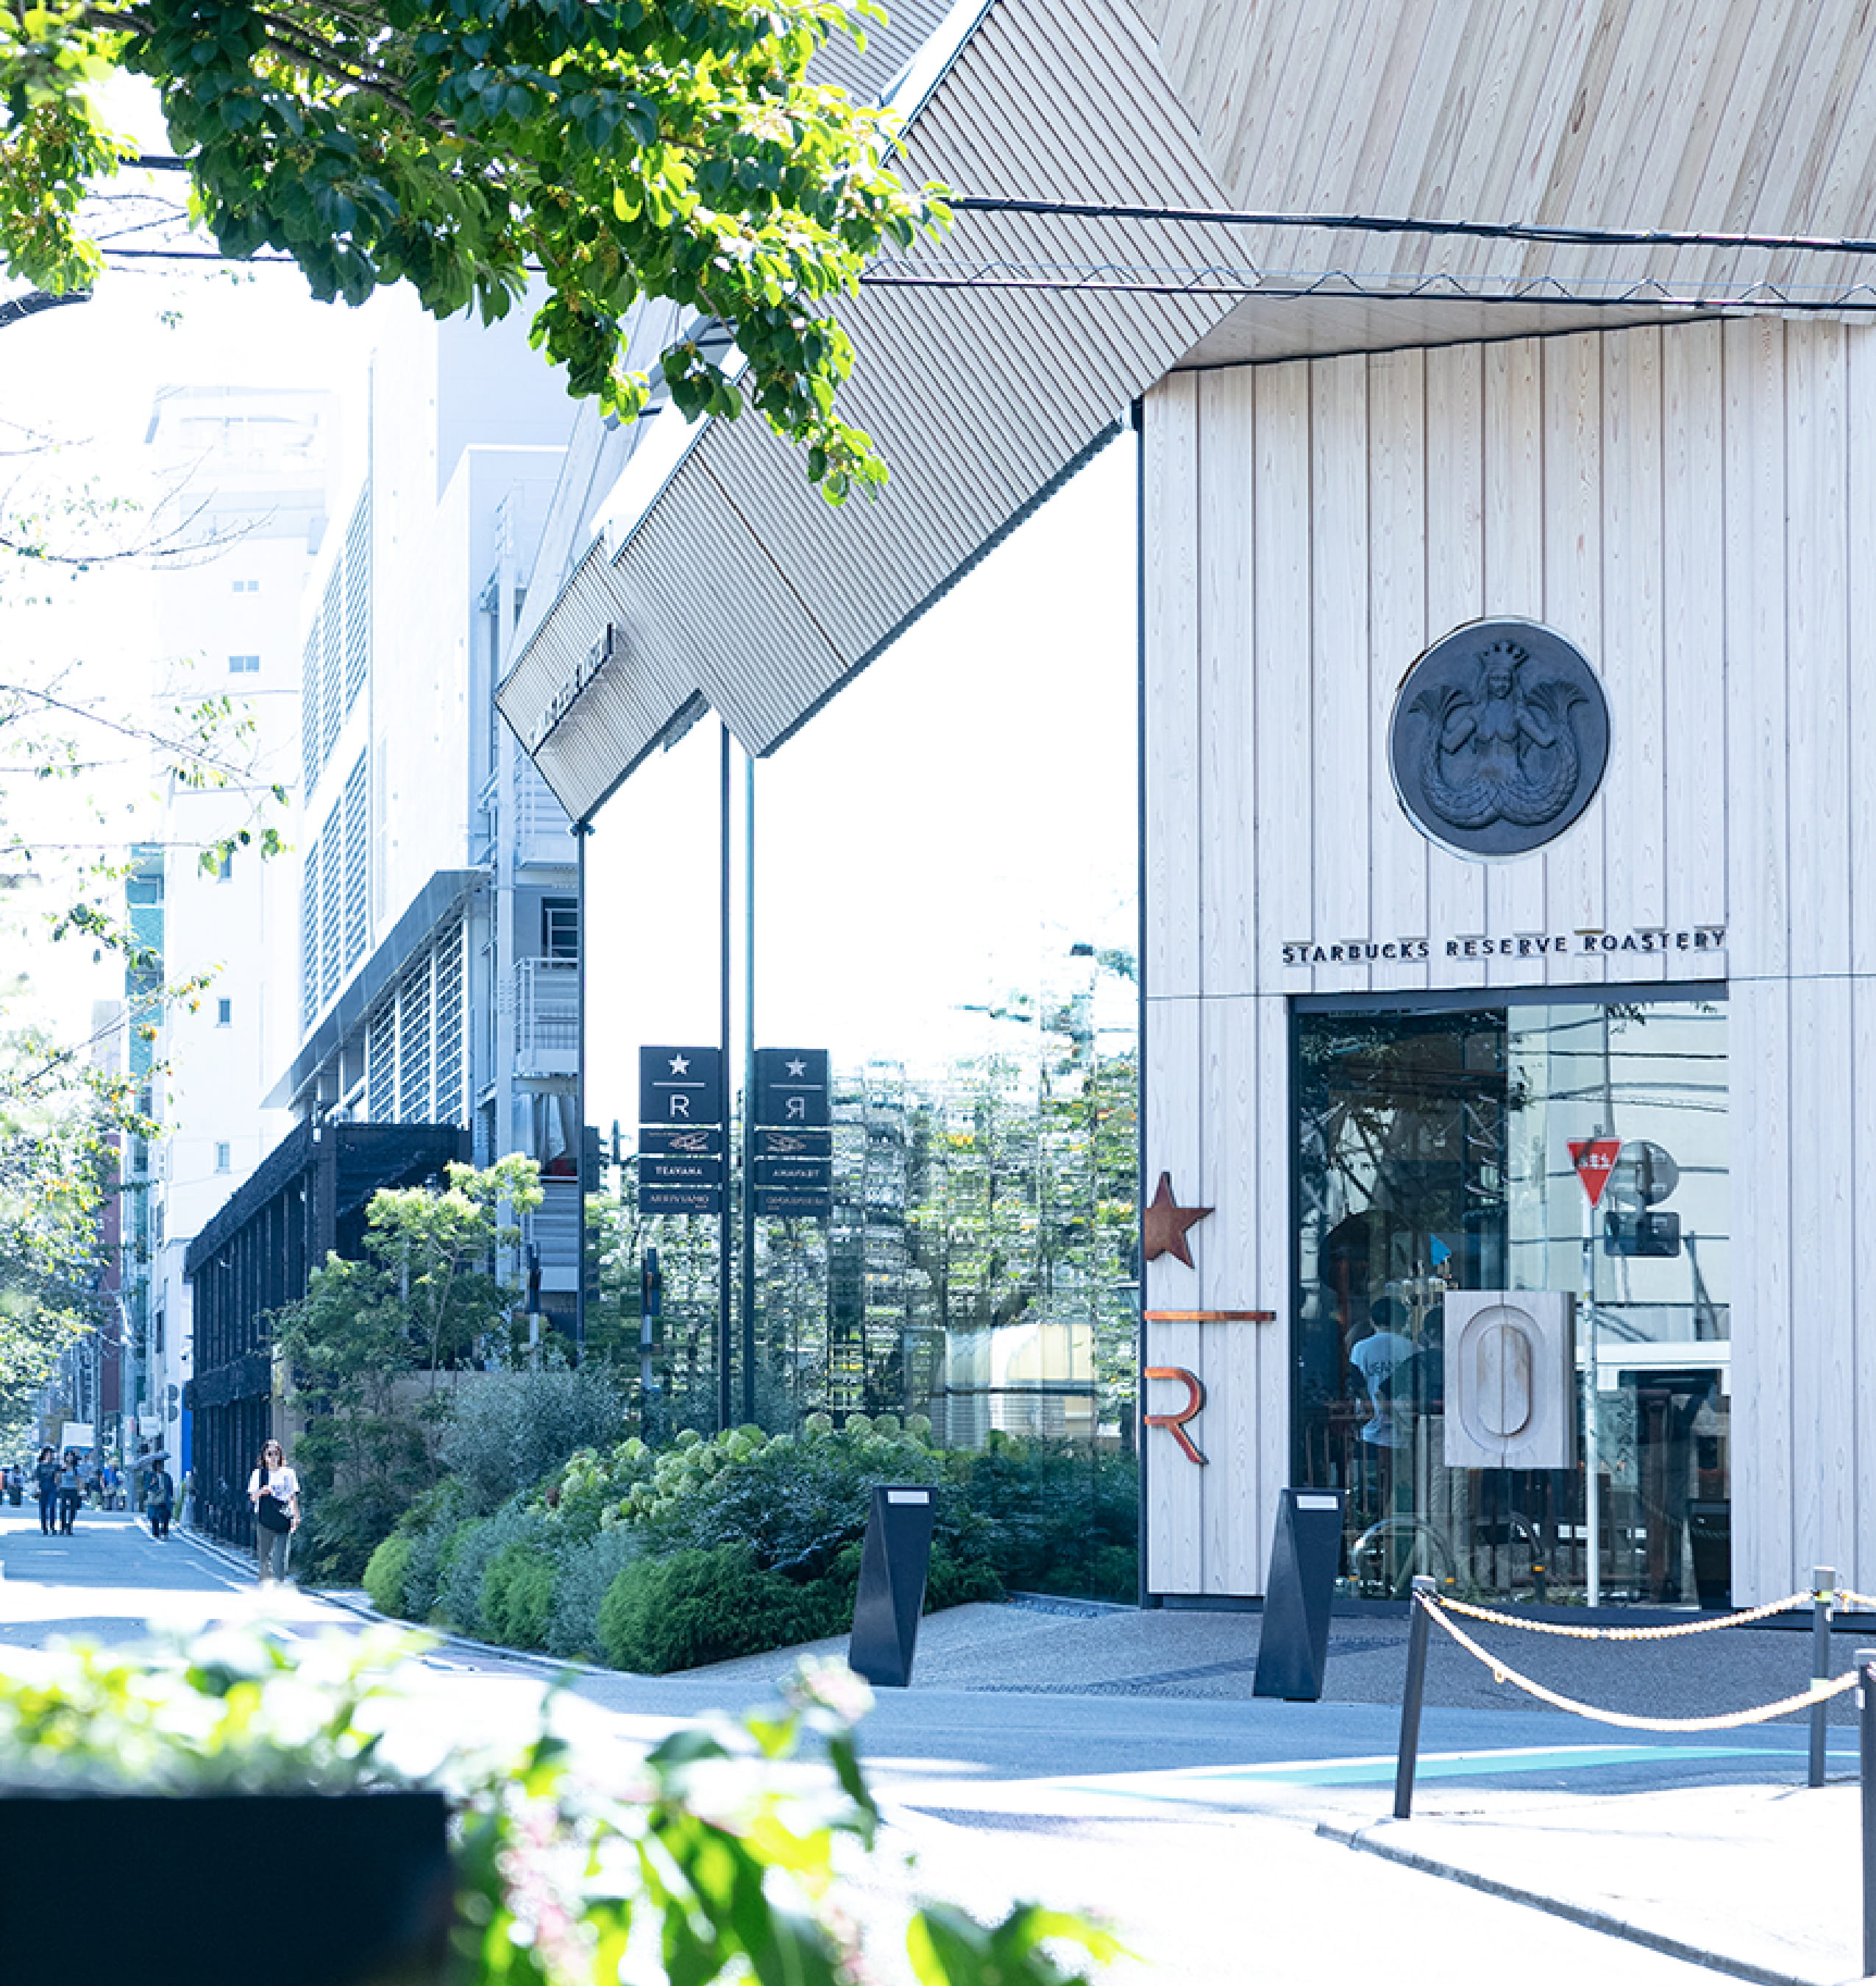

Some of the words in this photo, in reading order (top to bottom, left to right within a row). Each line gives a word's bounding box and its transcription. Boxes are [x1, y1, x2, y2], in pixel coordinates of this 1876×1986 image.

[1282, 939, 1430, 964] STARBUCKS
[1446, 934, 1568, 958] RESERVE
[1582, 929, 1726, 952] ROASTERY
[669, 1094, 690, 1118] R
[1144, 1366, 1210, 1466] R
